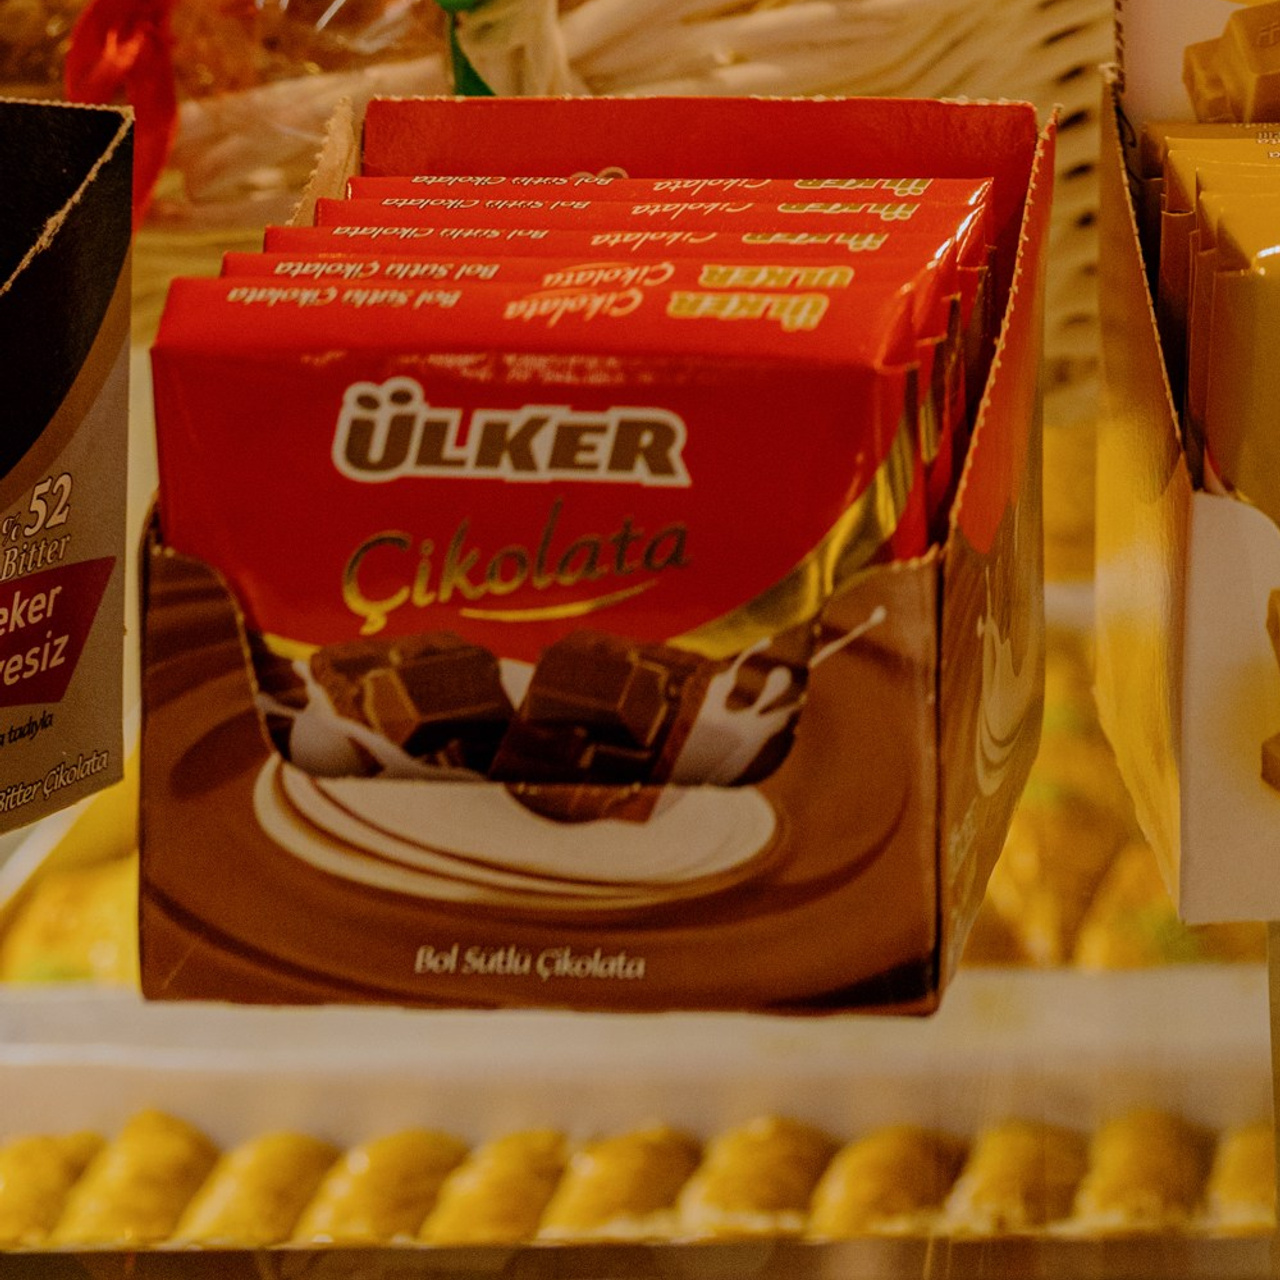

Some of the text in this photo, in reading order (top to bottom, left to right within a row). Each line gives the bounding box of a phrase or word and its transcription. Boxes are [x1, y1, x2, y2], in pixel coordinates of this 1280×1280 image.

[503, 288, 829, 332] ÜLKER Çikolata
[332, 377, 692, 487] ÜLKER
[0, 533, 71, 582] Bitter
[342, 499, 690, 630] Çikolata
[0, 630, 69, 686] esiz
[42, 749, 109, 800] Çikolata
[414, 942, 459, 974] Bol
[536, 945, 646, 983] Çikolata
